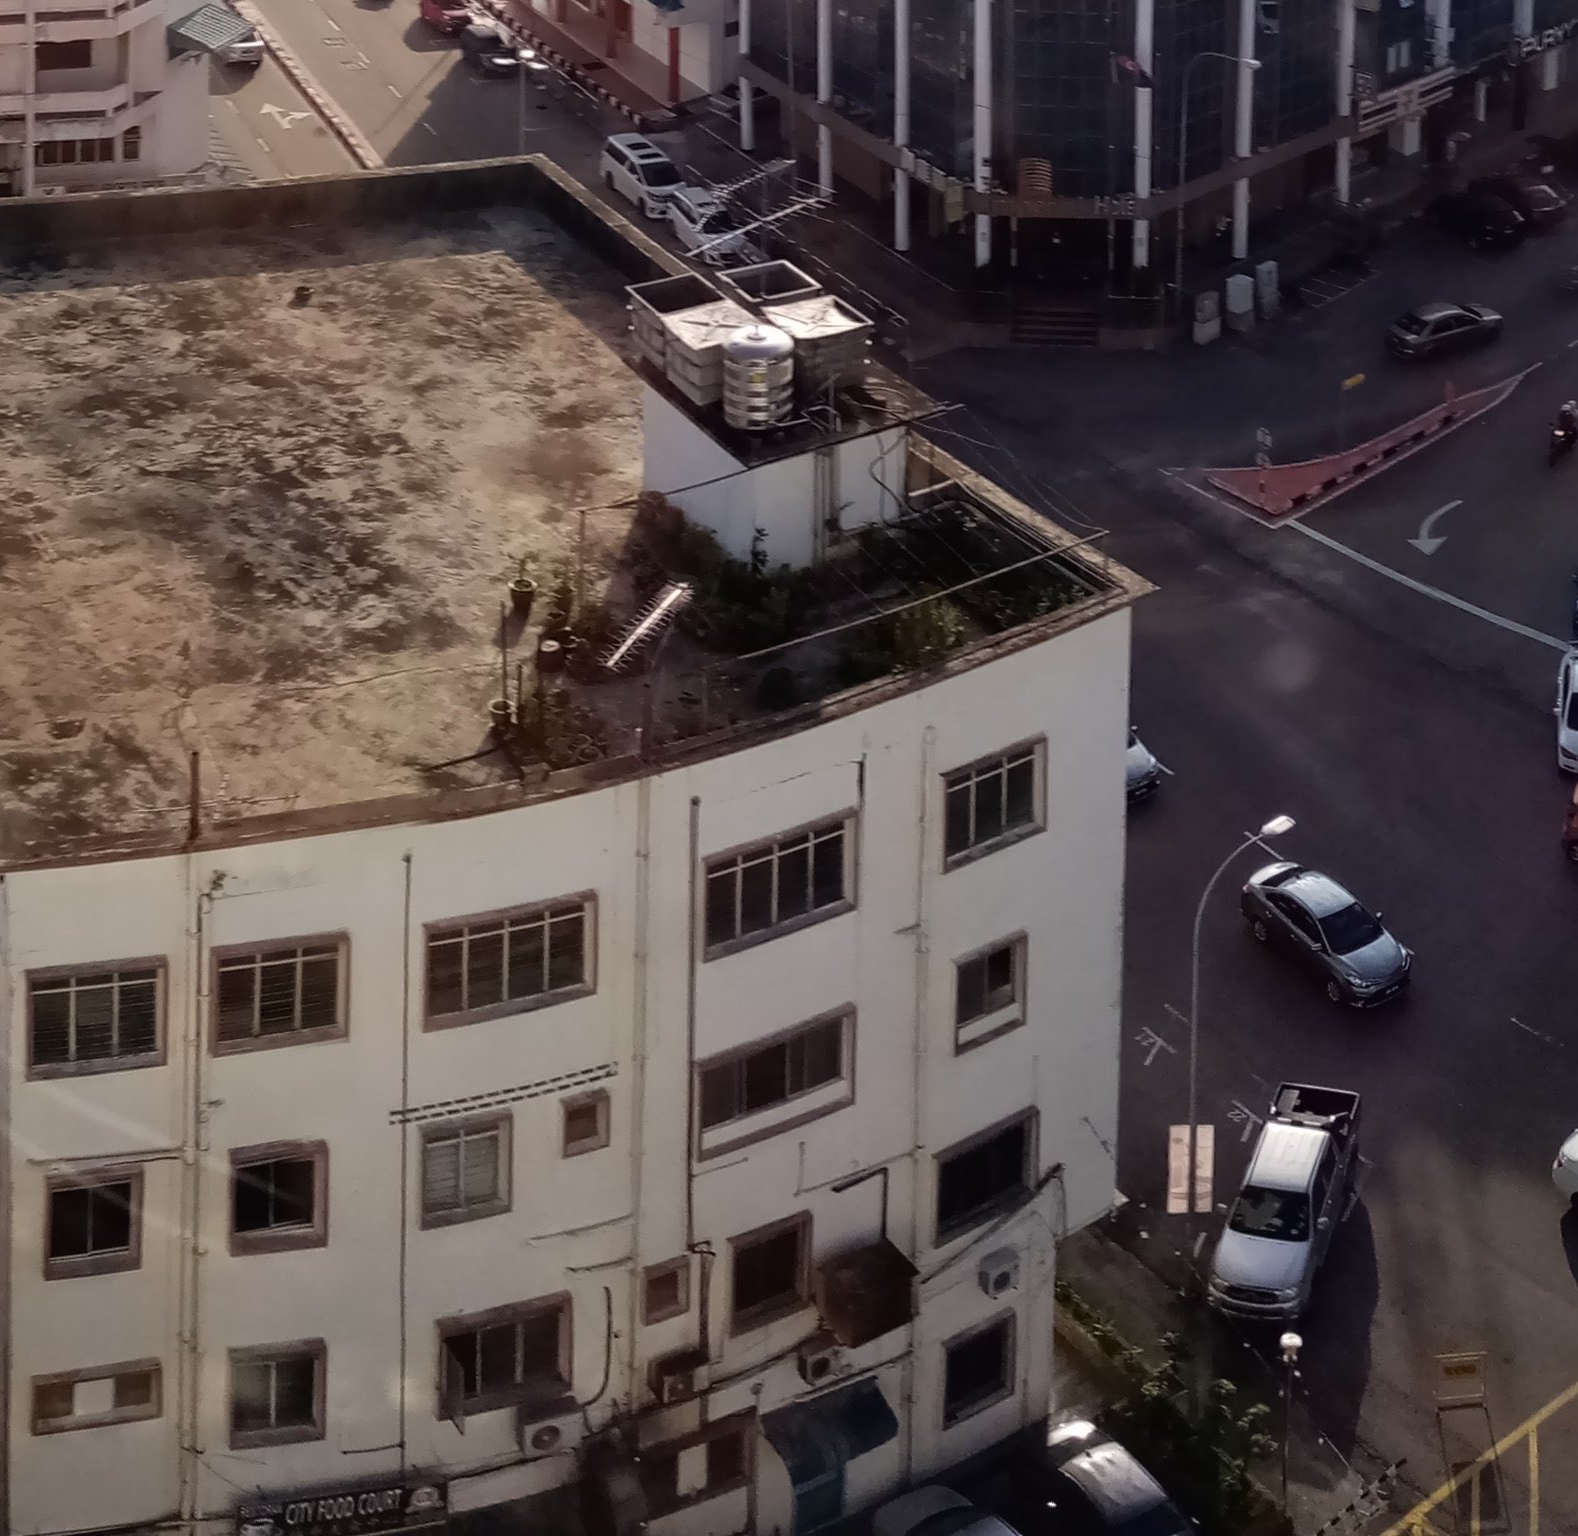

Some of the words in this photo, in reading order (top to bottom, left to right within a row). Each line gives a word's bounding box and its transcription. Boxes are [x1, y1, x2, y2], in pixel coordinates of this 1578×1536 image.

[285, 1503, 314, 1524] CITY
[317, 1495, 355, 1520] FOOD
[358, 1488, 403, 1515] COURT
